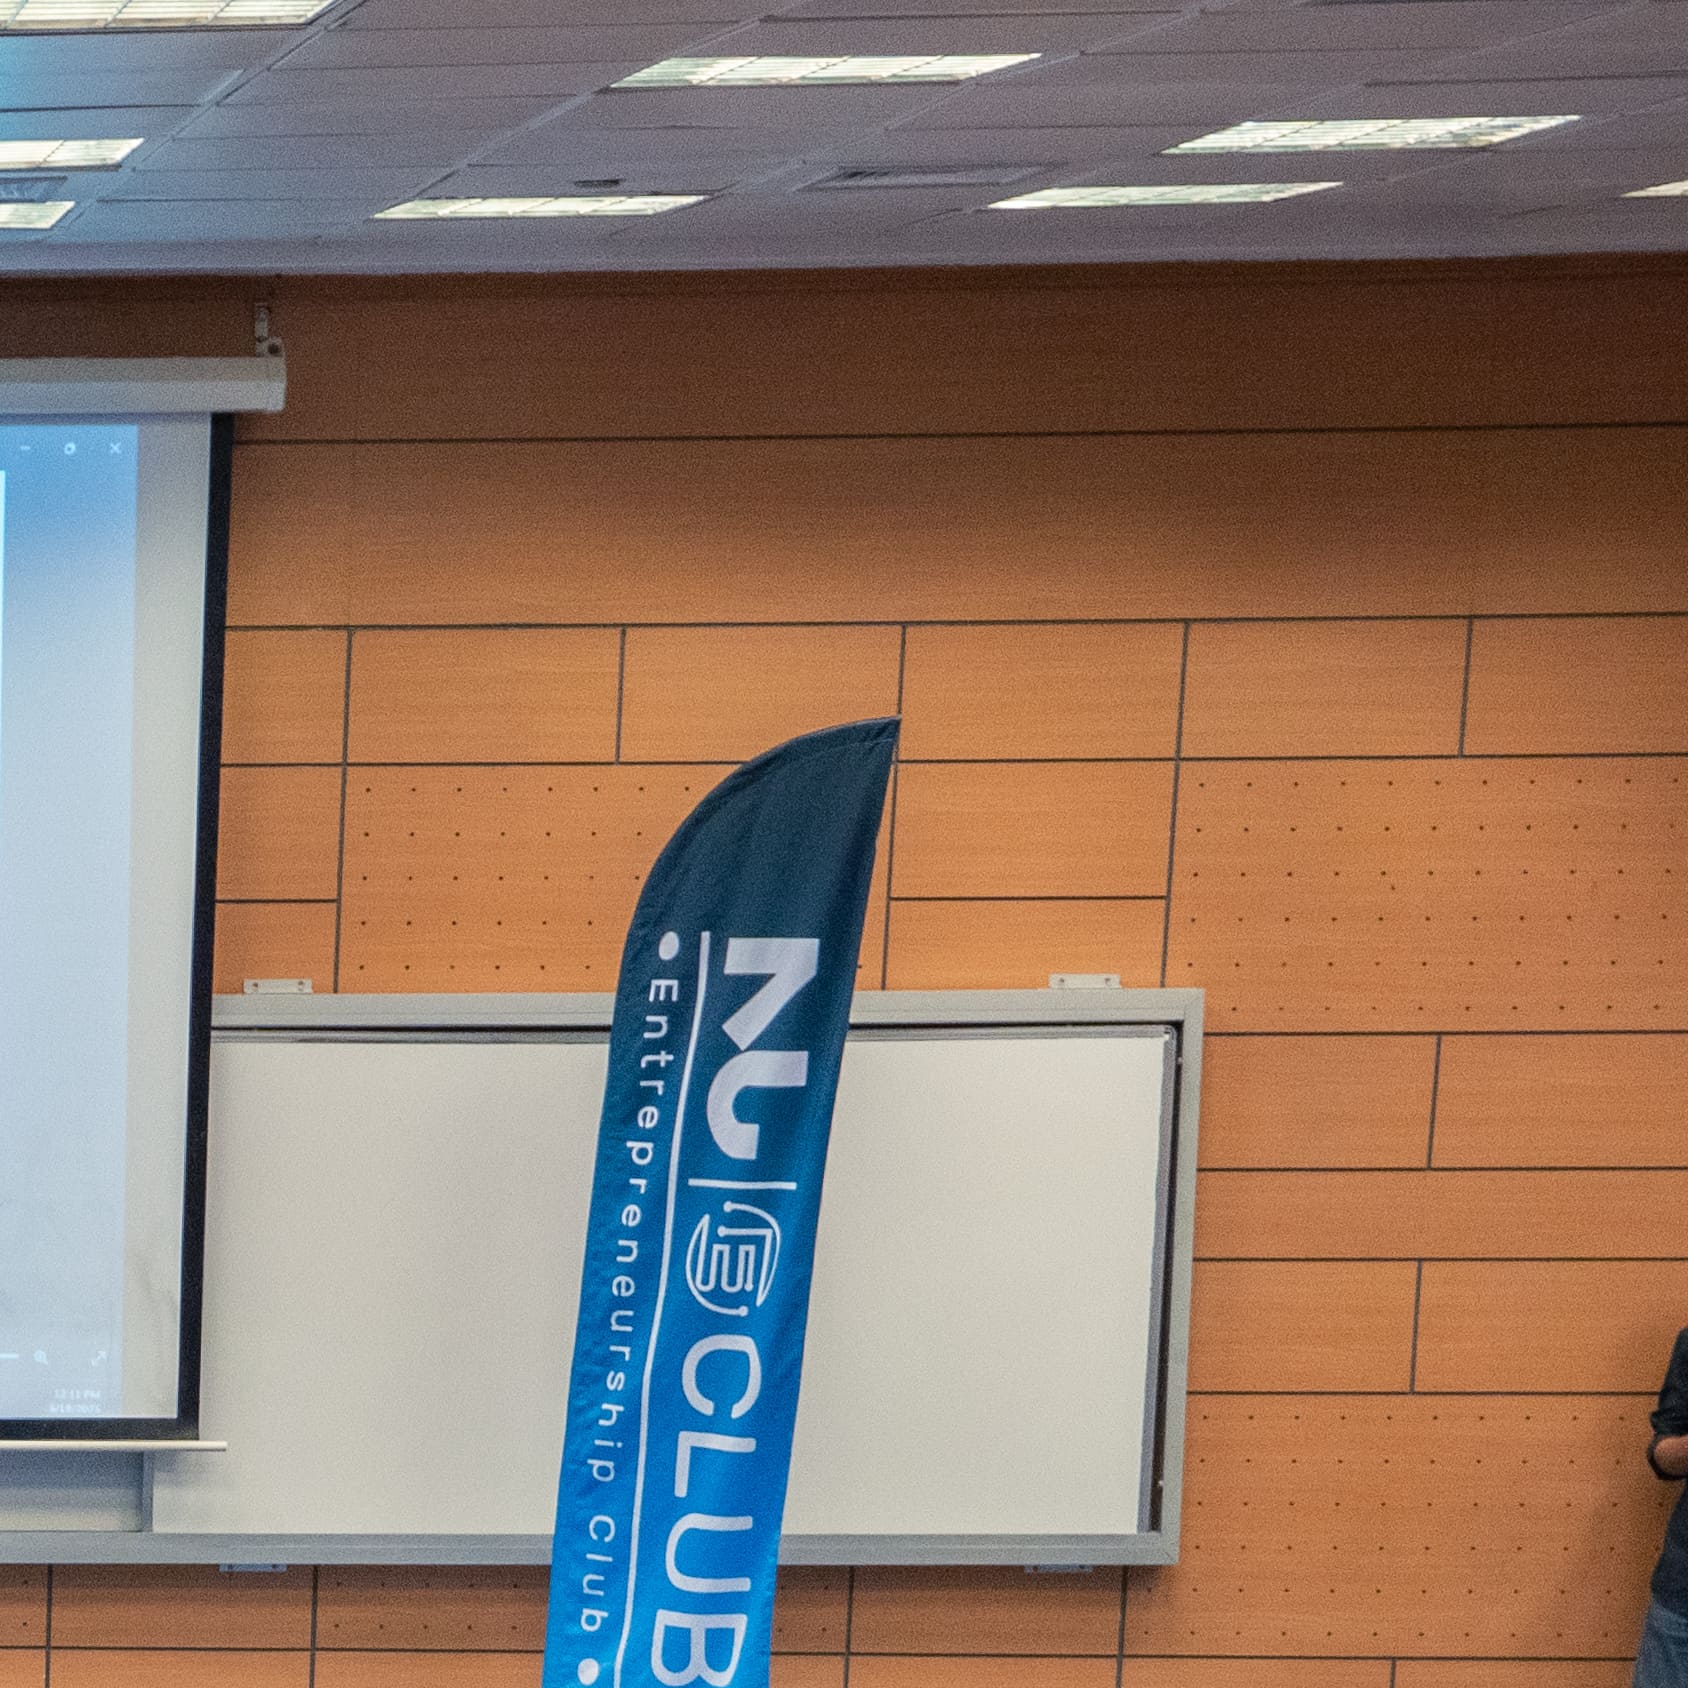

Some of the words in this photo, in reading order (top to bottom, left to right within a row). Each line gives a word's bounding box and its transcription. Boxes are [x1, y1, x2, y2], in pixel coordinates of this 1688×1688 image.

[706, 936, 819, 1161] NU
[590, 977, 679, 1483] Entrepreneurship
[580, 1516, 614, 1633] Club
[650, 1334, 762, 1688] CLUB
